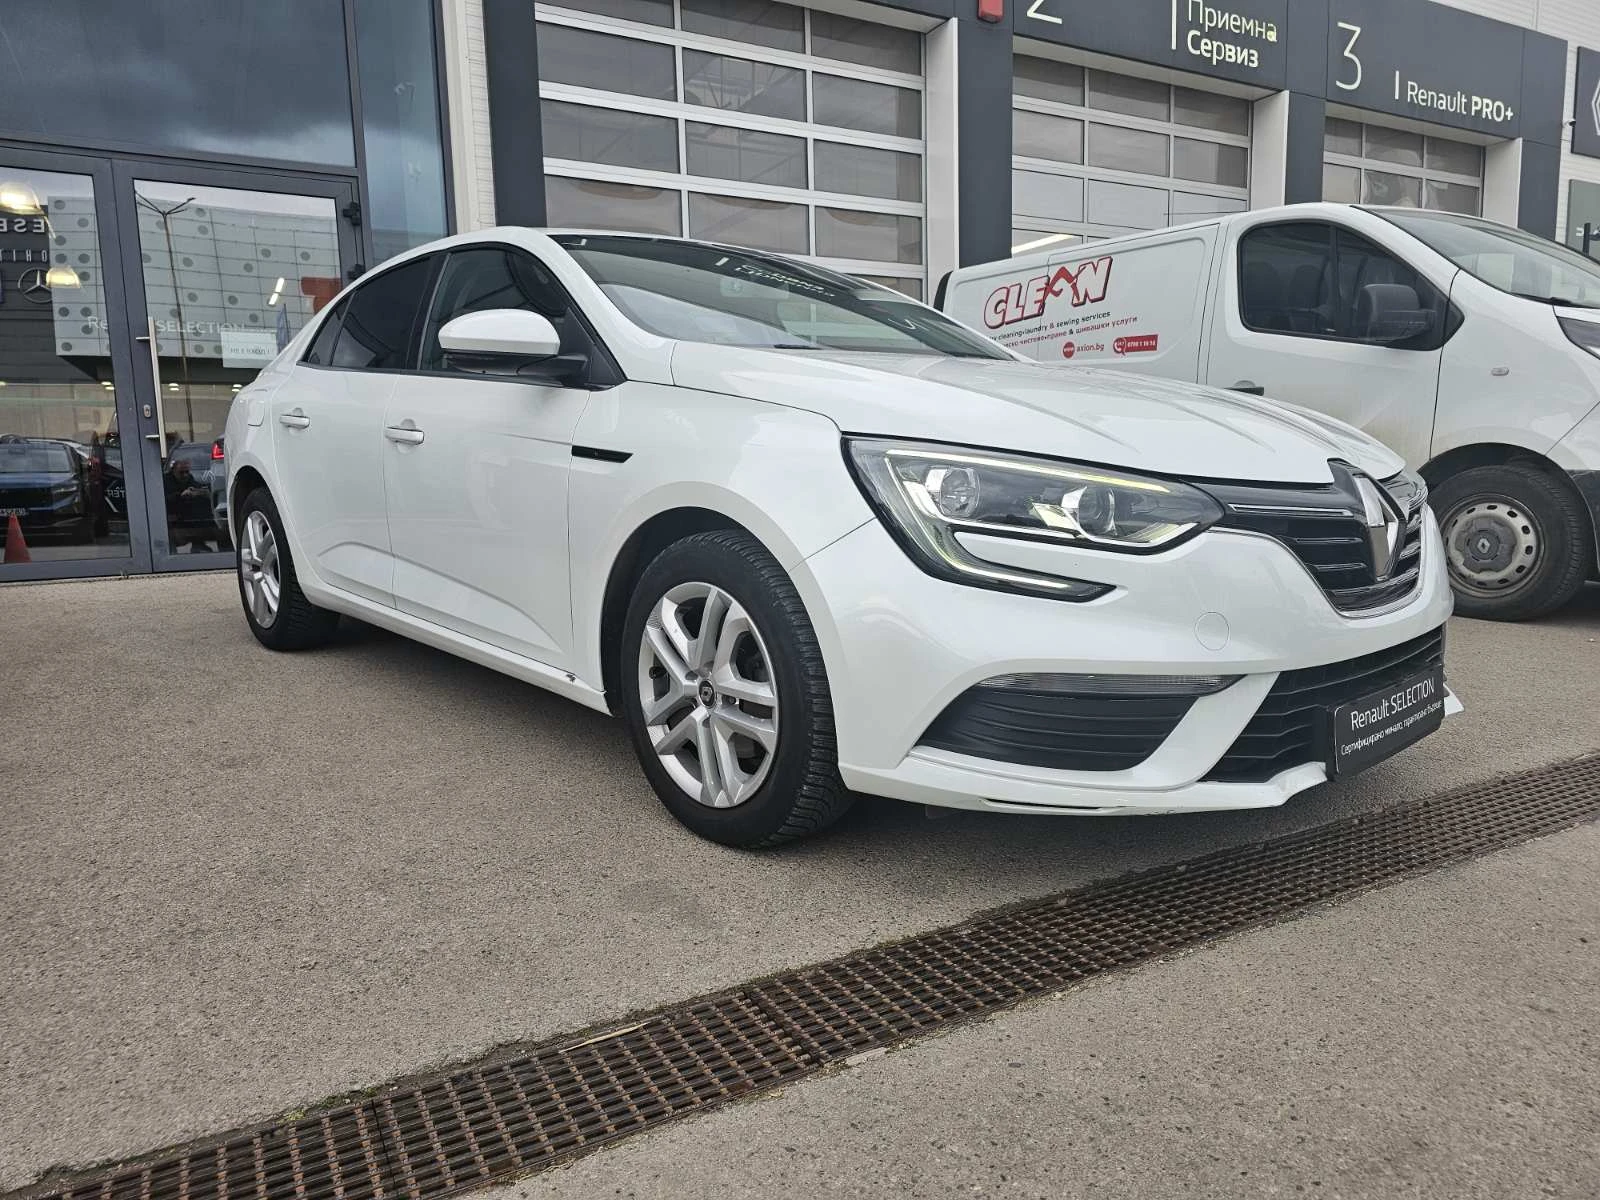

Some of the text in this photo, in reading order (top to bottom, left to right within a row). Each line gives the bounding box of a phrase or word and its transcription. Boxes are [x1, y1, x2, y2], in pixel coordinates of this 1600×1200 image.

[1188, 0, 1278, 42] Приемна
[1187, 30, 1260, 68] Сервиз
[1335, 21, 1362, 90] 3
[1407, 80, 1514, 122] Renault PRO+
[984, 256, 1113, 329] CLEAN
[1056, 317, 1080, 328] sewing
[1081, 310, 1111, 322] services
[1350, 677, 1435, 731] Renault SELECTION
[1340, 730, 1385, 756] Сертифицирано
